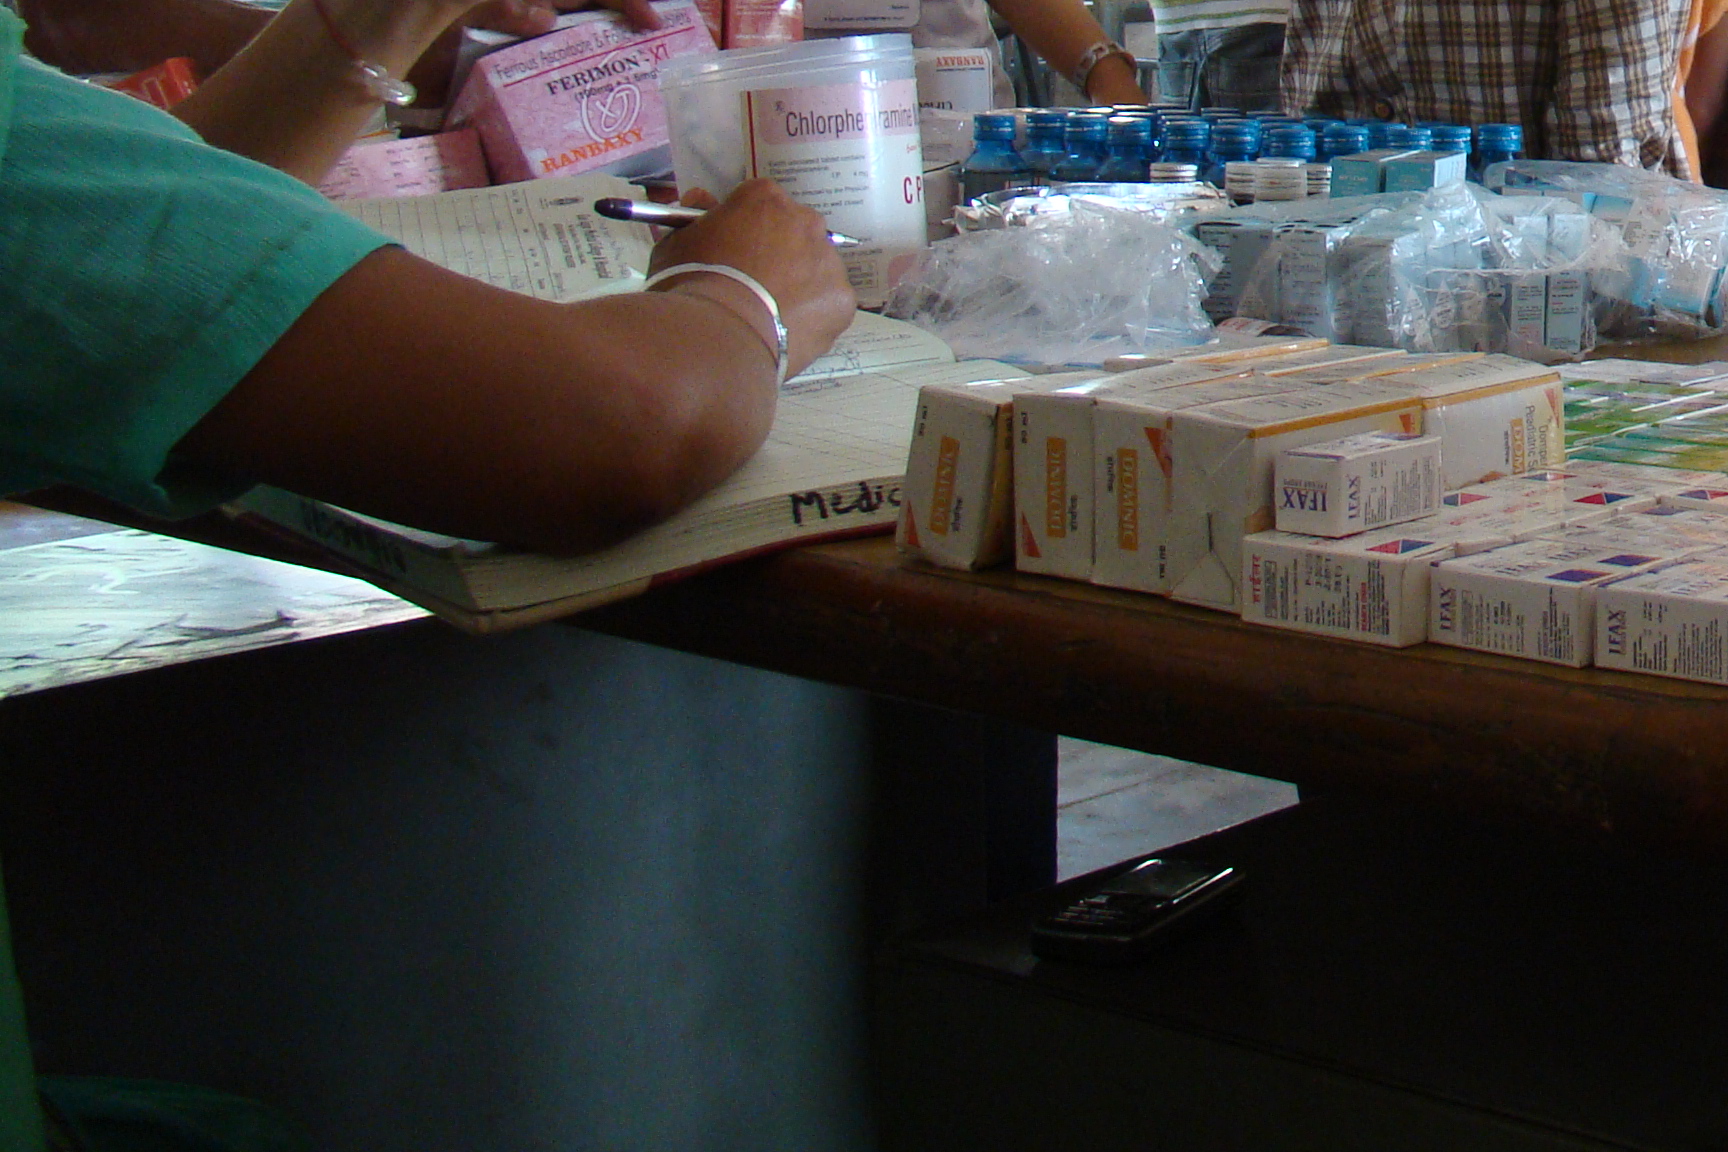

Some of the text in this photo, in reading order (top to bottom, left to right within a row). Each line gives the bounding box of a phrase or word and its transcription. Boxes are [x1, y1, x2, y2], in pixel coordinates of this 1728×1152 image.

[545, 57, 642, 95] FERIMON
[539, 127, 645, 174] RANBAXY
[789, 481, 901, 527] Medic
[1122, 456, 1136, 541] DOMNIC
[1283, 489, 1327, 512] IFAX
[1347, 476, 1359, 519] IFAX
[1439, 588, 1452, 630] IFAX
[1608, 609, 1621, 655] IFAX
